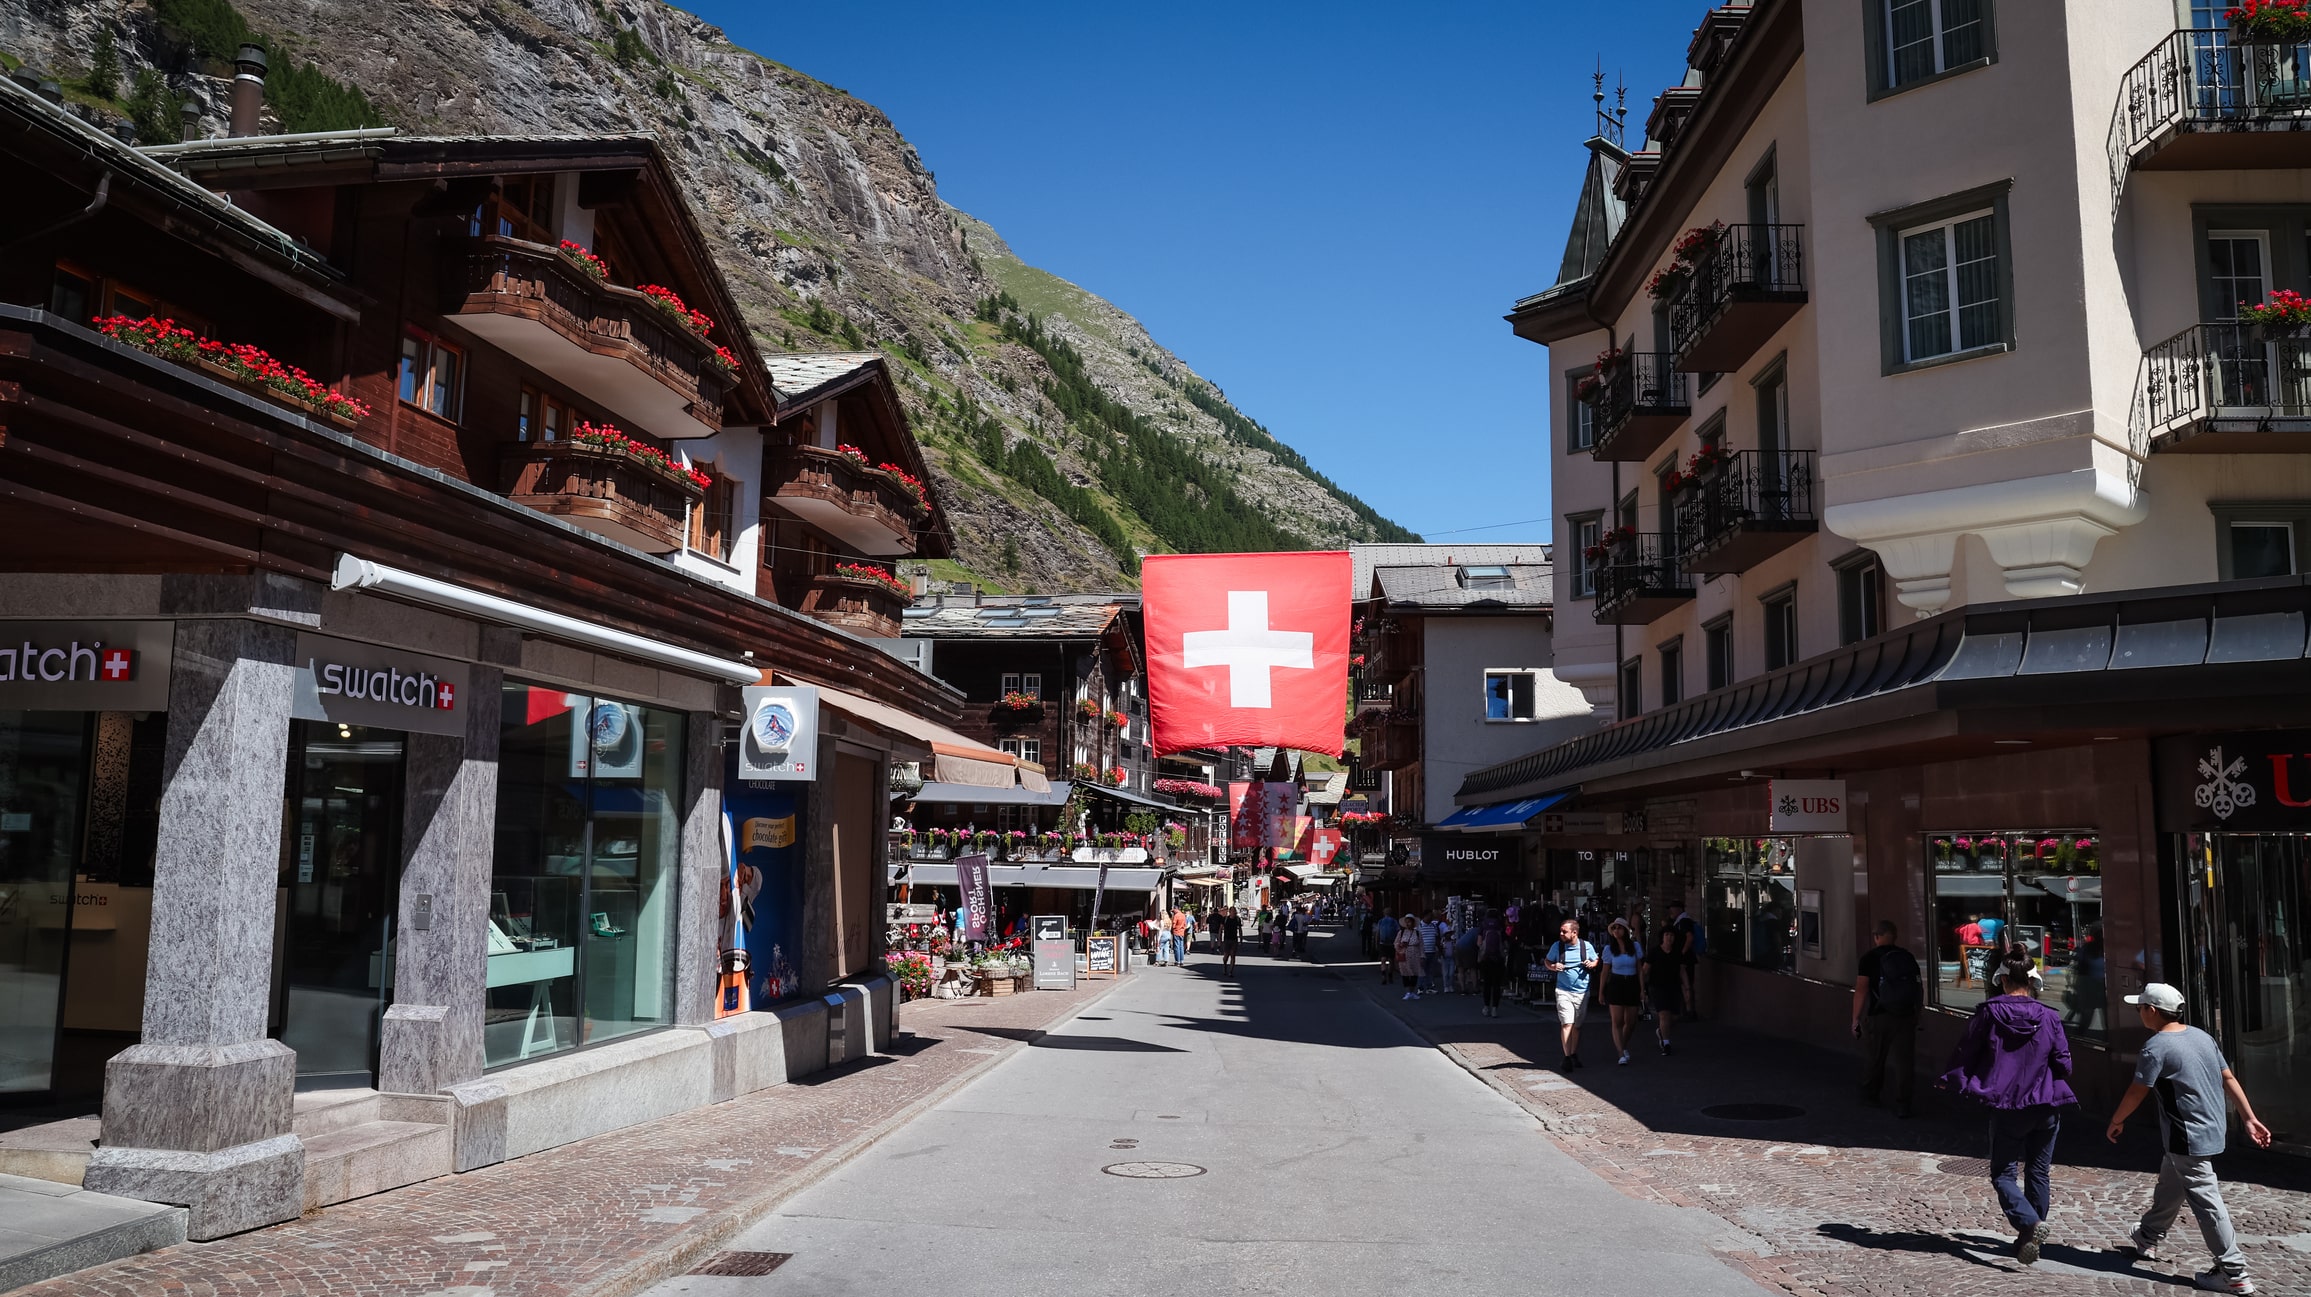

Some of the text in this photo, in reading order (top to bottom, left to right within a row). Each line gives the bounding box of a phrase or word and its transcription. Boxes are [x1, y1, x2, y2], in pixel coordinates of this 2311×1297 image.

[324, 663, 437, 709] swatch
[745, 760, 795, 773] swatch
[1801, 797, 1840, 814] UBS
[752, 829, 777, 843] chocolate
[1219, 816, 1228, 863] POLLUX
[1446, 850, 1500, 861] HUBLOT
[50, 893, 98, 905] swtch
